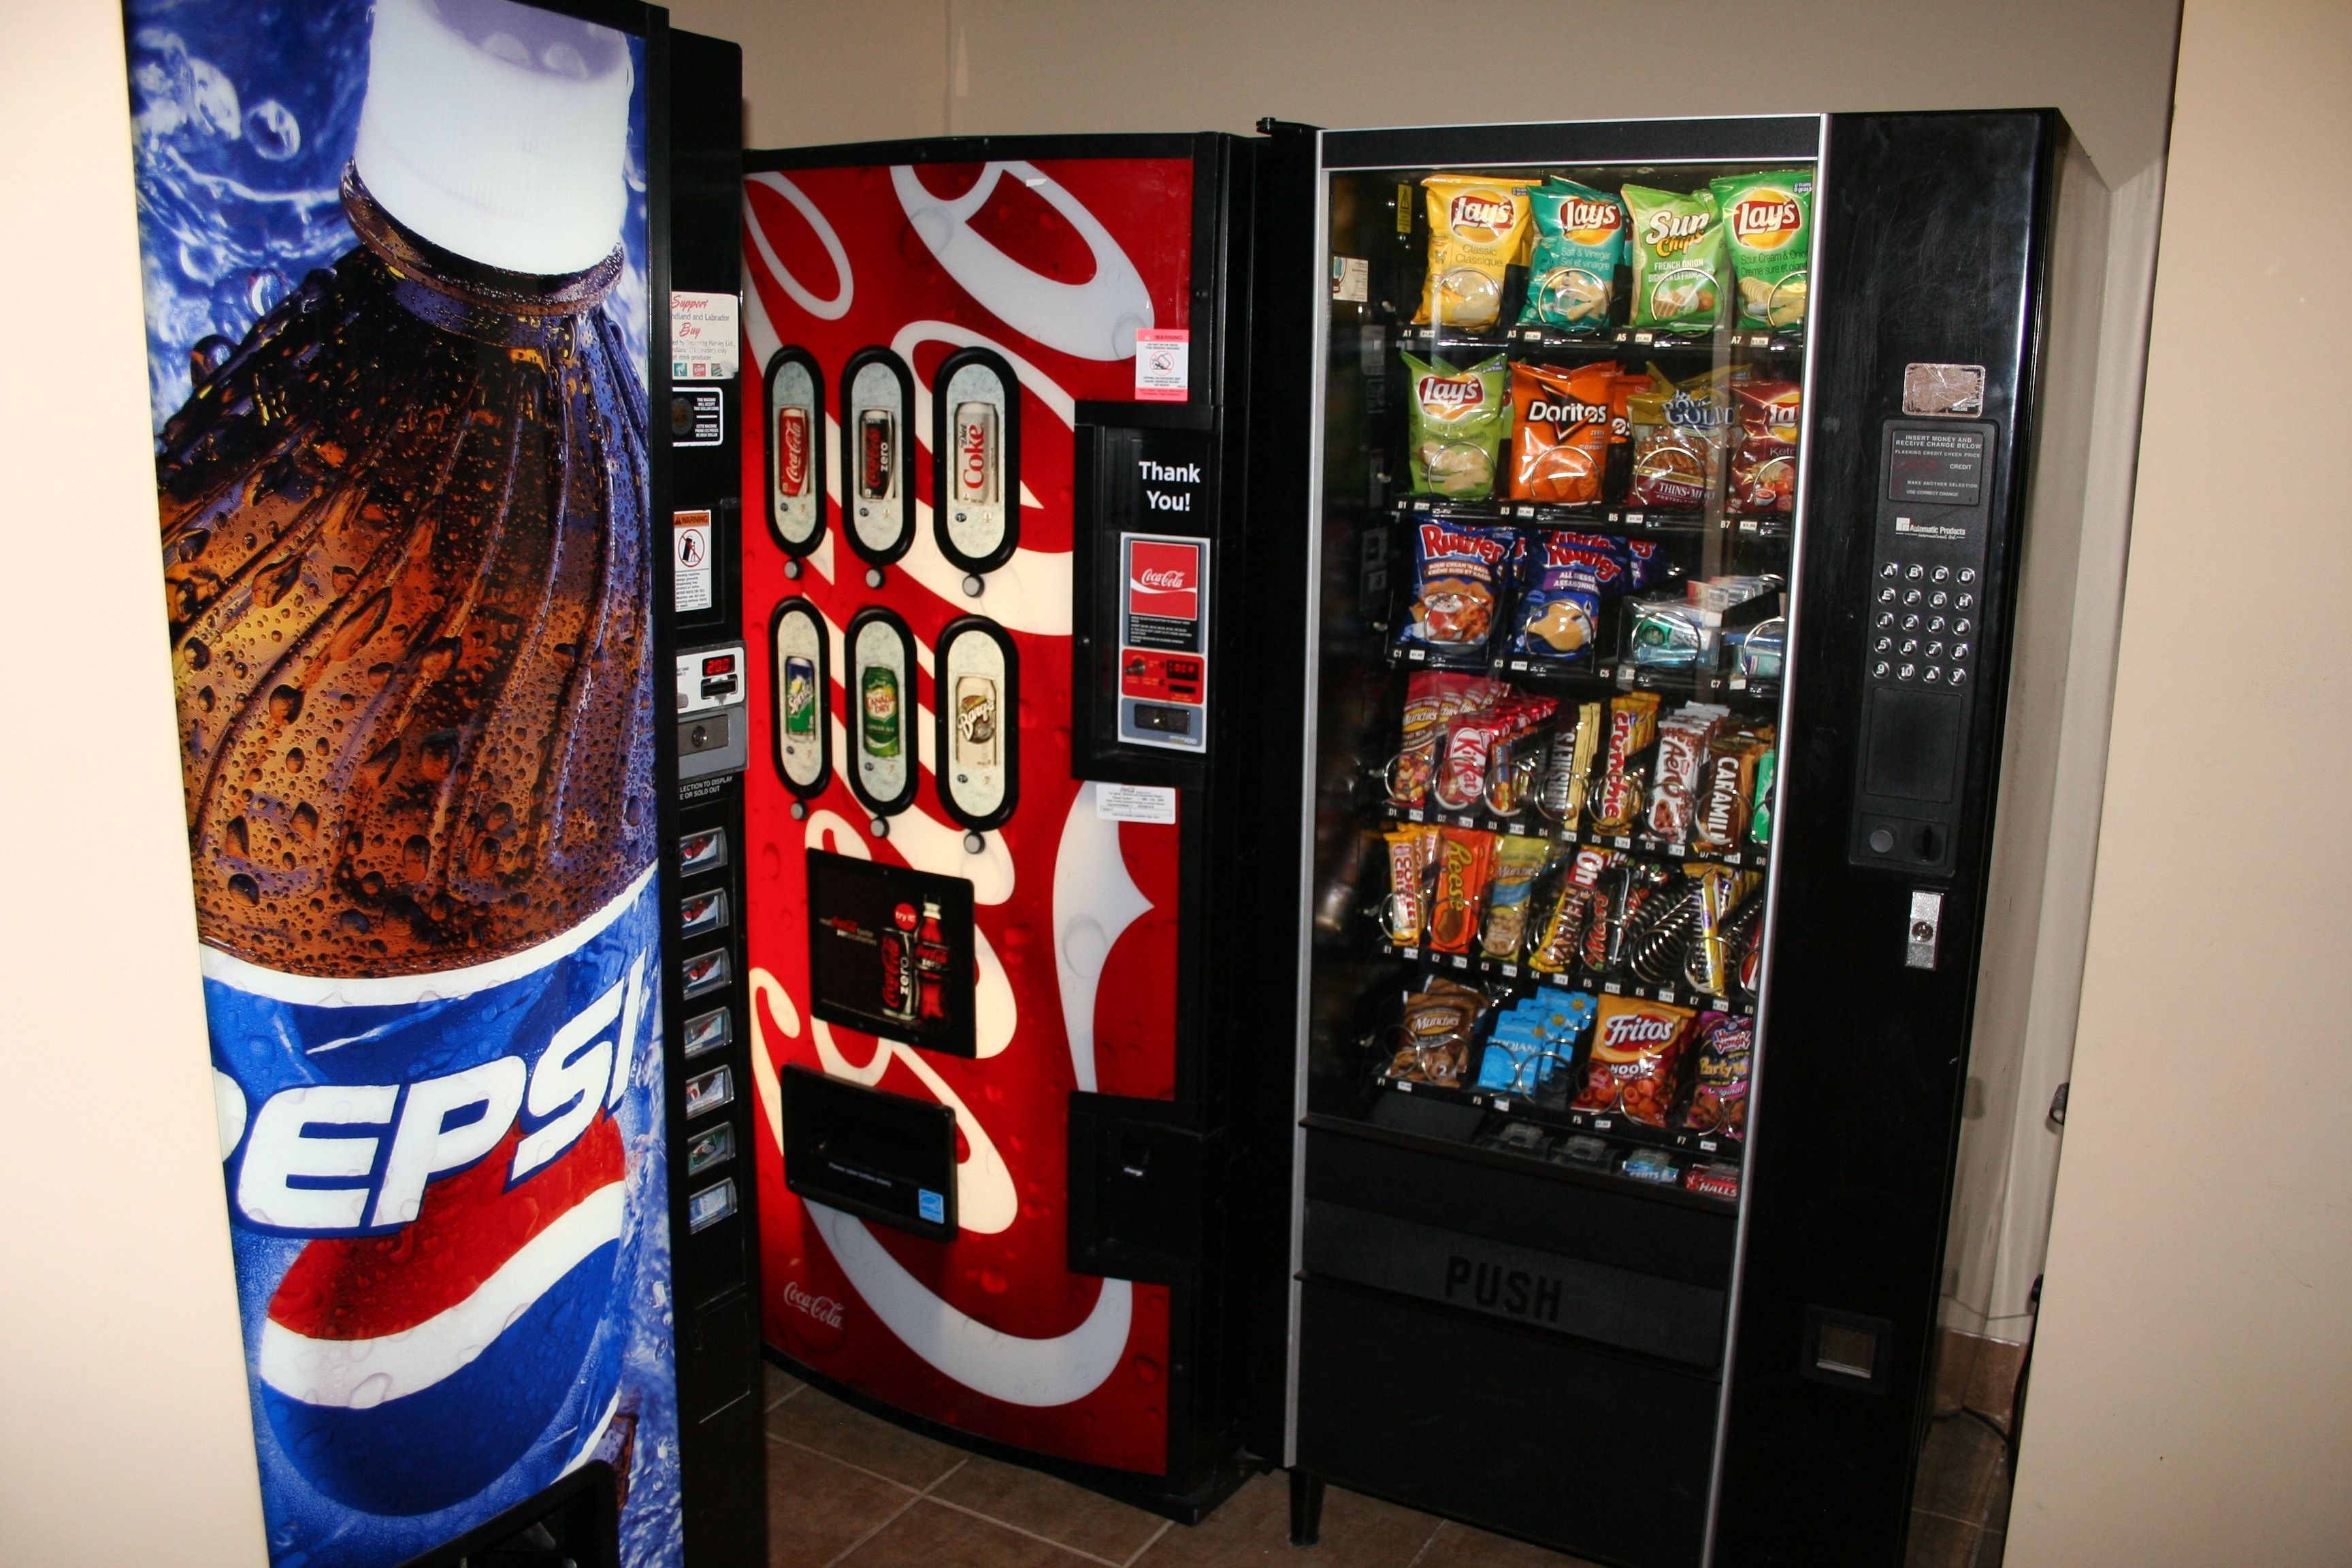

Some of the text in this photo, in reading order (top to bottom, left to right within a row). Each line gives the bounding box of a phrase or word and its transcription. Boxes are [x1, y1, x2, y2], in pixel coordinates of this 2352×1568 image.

[1452, 197, 1512, 235] Lay's
[1567, 201, 1616, 231] Lay's
[1739, 202, 1795, 235] Lay's
[1645, 210, 1710, 246] Sun
[1463, 244, 1497, 256] Classic
[1455, 253, 1503, 267] Classique
[1654, 258, 1703, 271] FRENCH ONION
[1741, 255, 1757, 265] Sour
[1759, 252, 1782, 263] Cream
[679, 323, 701, 339] Buy
[1731, 336, 1741, 344] A7
[1424, 378, 1480, 405] Lay's
[1529, 402, 1607, 423] Doritos
[963, 425, 985, 489] Coke
[1139, 461, 1200, 483] Thank
[1146, 490, 1190, 511] You!
[1910, 524, 1965, 536] Automatic Products
[1884, 566, 1971, 581] A B C D
[1882, 591, 1968, 606] E F G H
[1906, 618, 1914, 627] 2
[1931, 620, 1938, 629] 3
[1957, 622, 1965, 632] 4
[1879, 640, 1963, 657] 5 6 7 8
[1878, 665, 1913, 676] 9 10
[875, 705, 889, 714] DRY
[957, 699, 994, 740] Barq's
[712, 776, 733, 785] DISPLAY
[694, 788, 708, 797] SOLD
[1448, 840, 1472, 911] Reese
[922, 958, 941, 969] zero
[900, 956, 909, 995] zero
[1414, 1017, 1460, 1030] Munchies
[1605, 1015, 1673, 1046] Fritos
[1699, 1183, 1737, 1197] HALLS
[1445, 1256, 1563, 1322] PUSH
